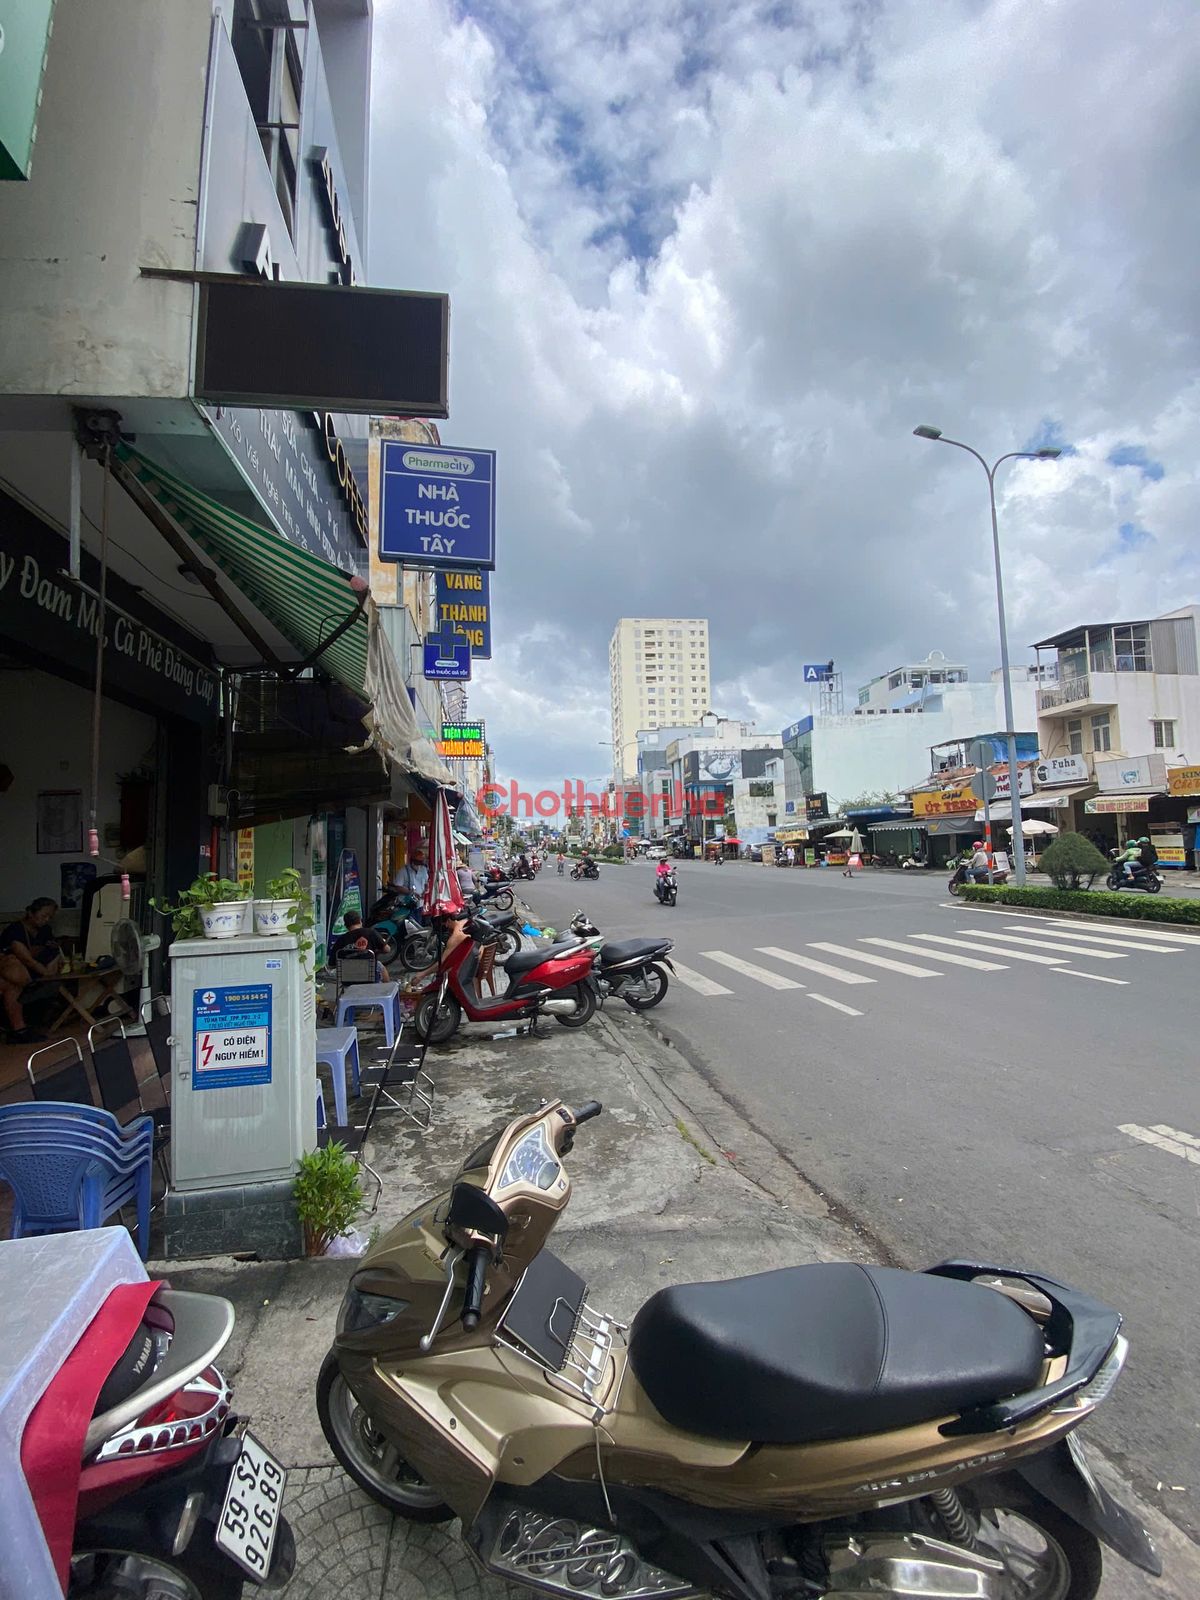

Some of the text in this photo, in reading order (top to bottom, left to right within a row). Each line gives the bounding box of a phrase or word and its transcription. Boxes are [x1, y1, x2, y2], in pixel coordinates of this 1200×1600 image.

[259, 409, 281, 463] THAY
[408, 456, 469, 472] Pharmacity
[418, 482, 459, 501] NHÀ
[405, 506, 471, 529] THUỐC
[420, 533, 455, 554] TÂY
[20, 555, 73, 621] Đam
[114, 617, 135, 657] Cà
[137, 630, 163, 673] Phê
[441, 600, 487, 622] THÀNH
[443, 726, 480, 739] TIỆM VÀNG
[441, 739, 482, 756] THÀNH CÔNG
[1052, 758, 1076, 769] Fuha
[223, 1036, 256, 1047] CÓ ĐIỆN
[215, 1051, 237, 1061] NGUY
[239, 1048, 260, 1060] HIỂM
[245, 1460, 282, 1571] 926.89
